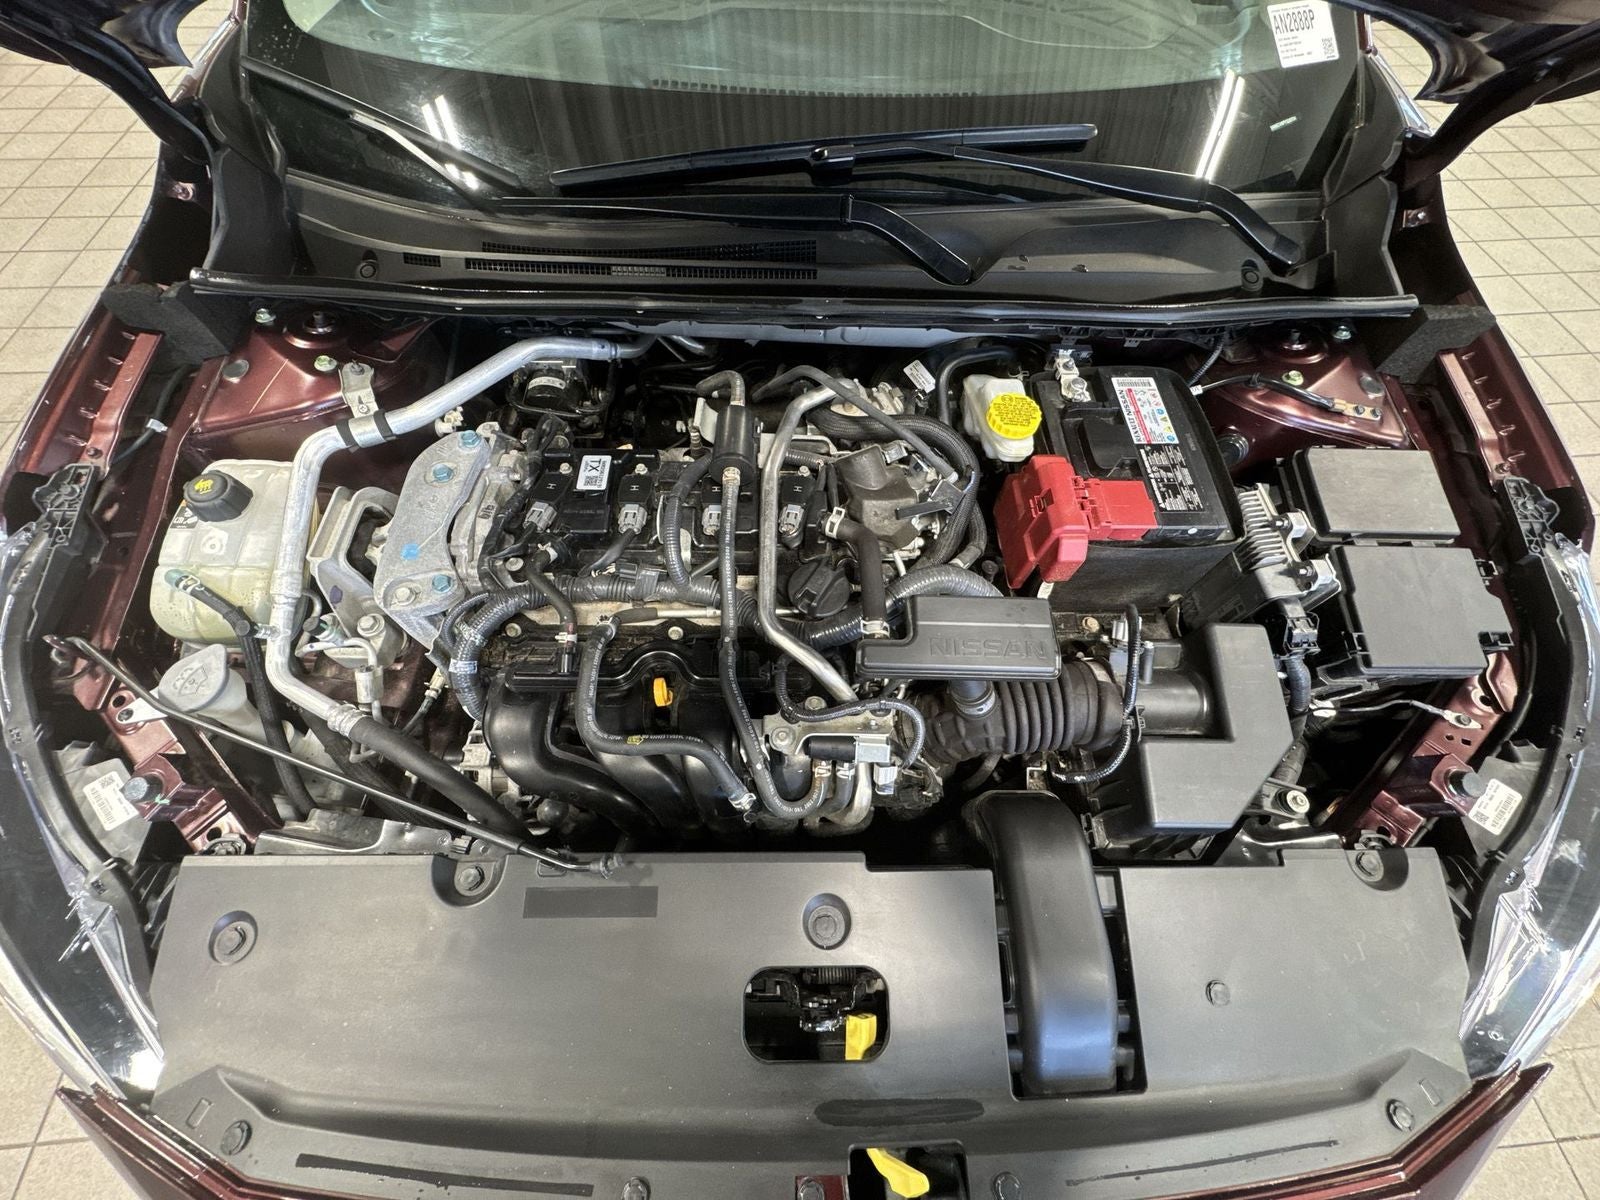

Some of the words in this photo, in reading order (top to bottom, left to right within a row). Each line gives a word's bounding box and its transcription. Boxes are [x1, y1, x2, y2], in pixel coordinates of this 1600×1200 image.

[1273, 9, 1315, 34] AN2888P
[1118, 389, 1132, 416] NISSAN
[928, 637, 1048, 660] NISSAN
